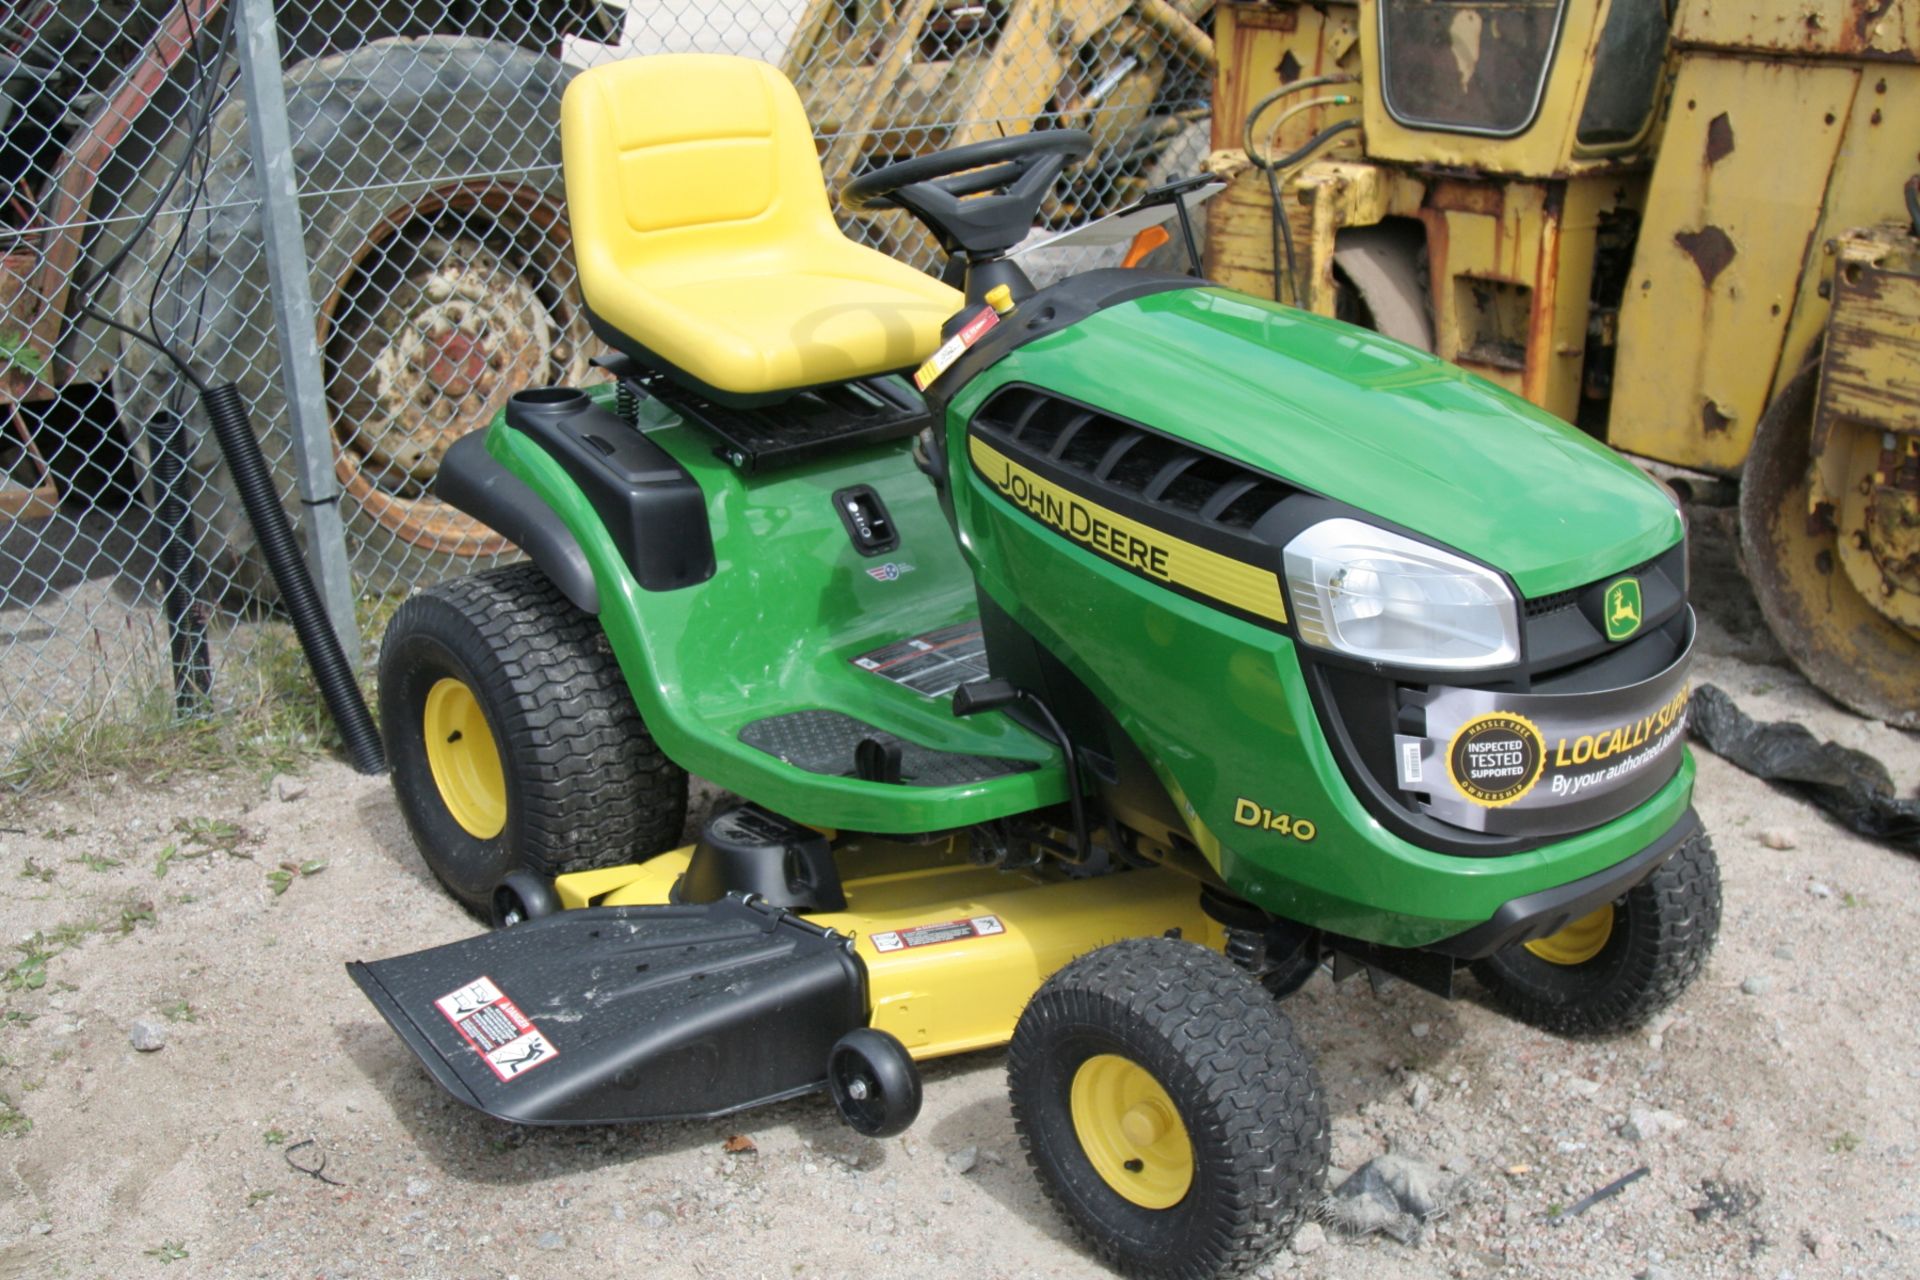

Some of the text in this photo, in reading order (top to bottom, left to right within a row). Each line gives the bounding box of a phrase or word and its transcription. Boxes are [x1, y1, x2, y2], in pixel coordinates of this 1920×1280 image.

[999, 462, 1169, 577] JOHN DEERE
[1468, 720, 1532, 738] HASSLE FREE
[1468, 740, 1523, 753] INSPECTED
[1556, 711, 1657, 767] LOCALLY
[1469, 751, 1523, 768] TESTED
[1551, 774, 1571, 797] By
[1570, 769, 1606, 795] your
[1606, 737, 1662, 780] authorized
[1471, 766, 1524, 779] SUPPORTED
[1462, 781, 1523, 800] OWNERSHIP
[1234, 797, 1316, 841] D140
